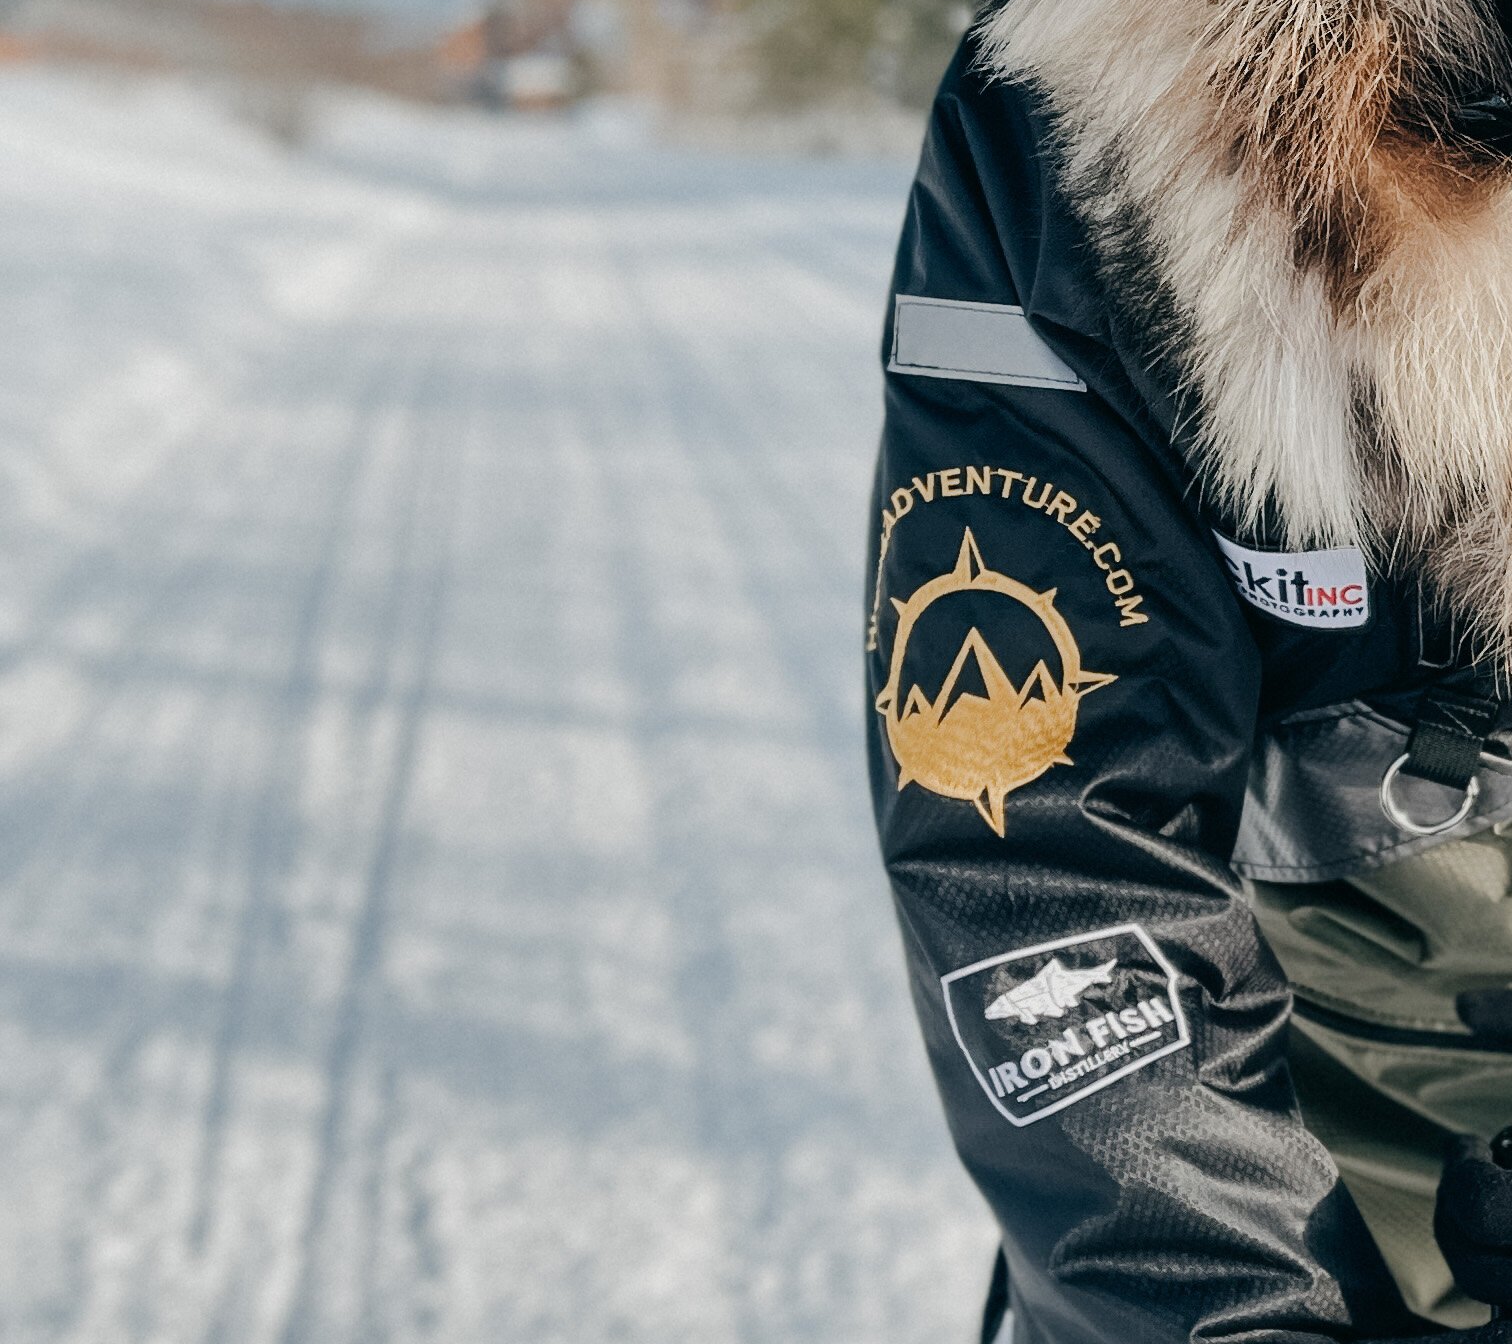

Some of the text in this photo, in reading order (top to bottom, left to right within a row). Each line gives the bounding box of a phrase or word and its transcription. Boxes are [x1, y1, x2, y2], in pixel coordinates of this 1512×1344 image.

[988, 997, 1175, 1098] IRON FISH
[1047, 1040, 1131, 1090] DISTILLERY
